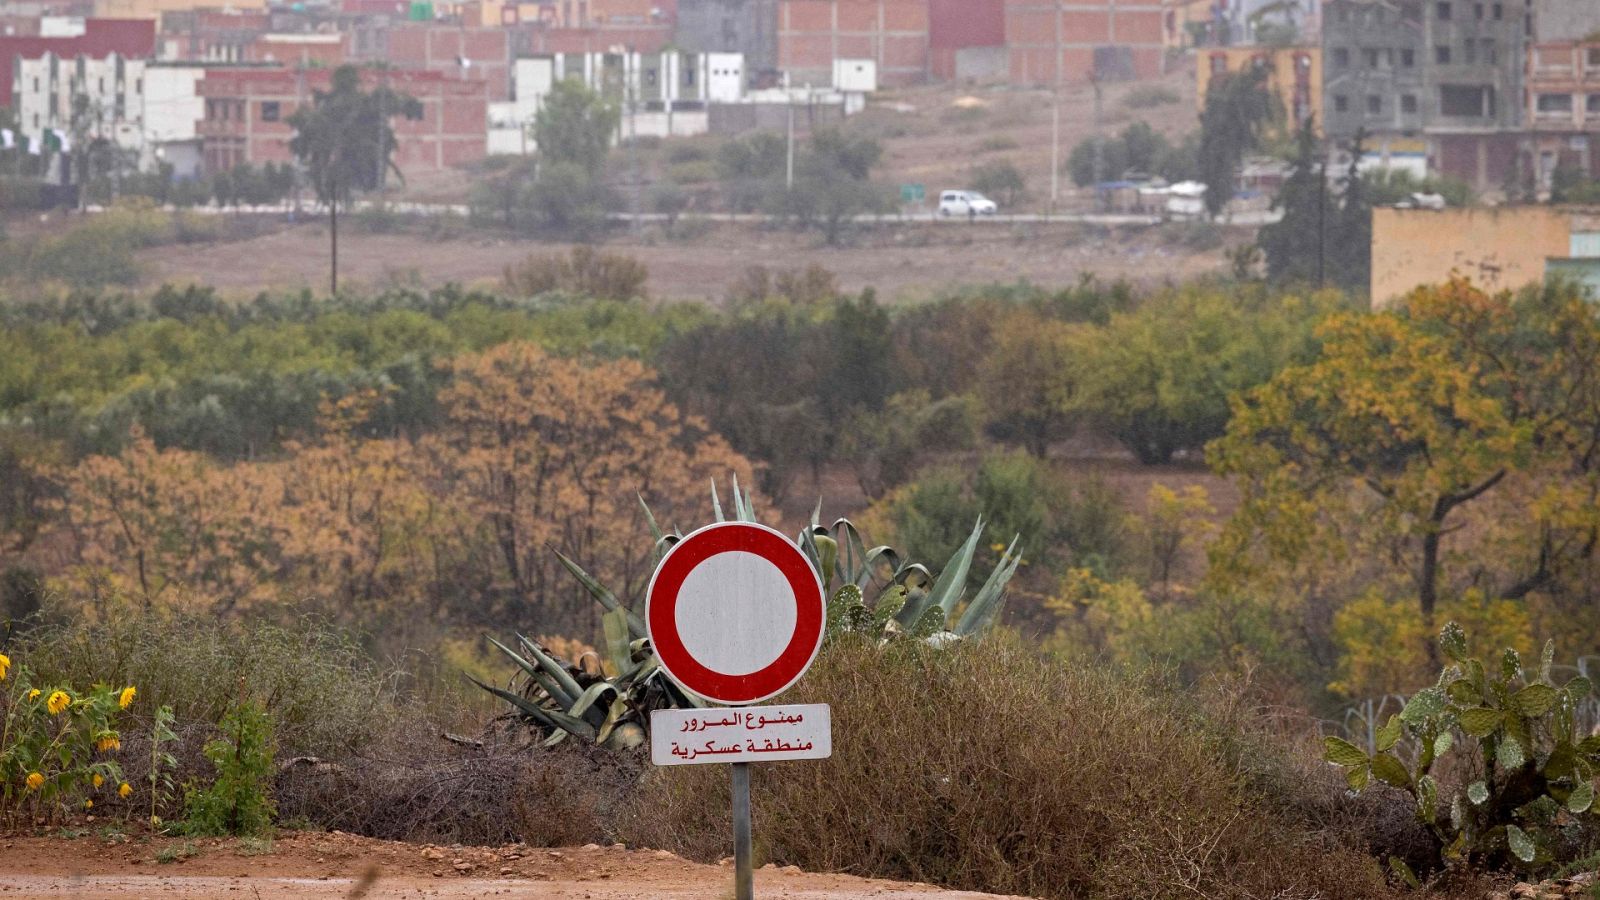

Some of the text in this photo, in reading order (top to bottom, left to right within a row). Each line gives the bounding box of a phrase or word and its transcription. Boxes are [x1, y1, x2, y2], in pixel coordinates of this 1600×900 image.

[680, 711, 803, 732] ممنوع المرور
[671, 738, 813, 759] منطقة عسكرية
